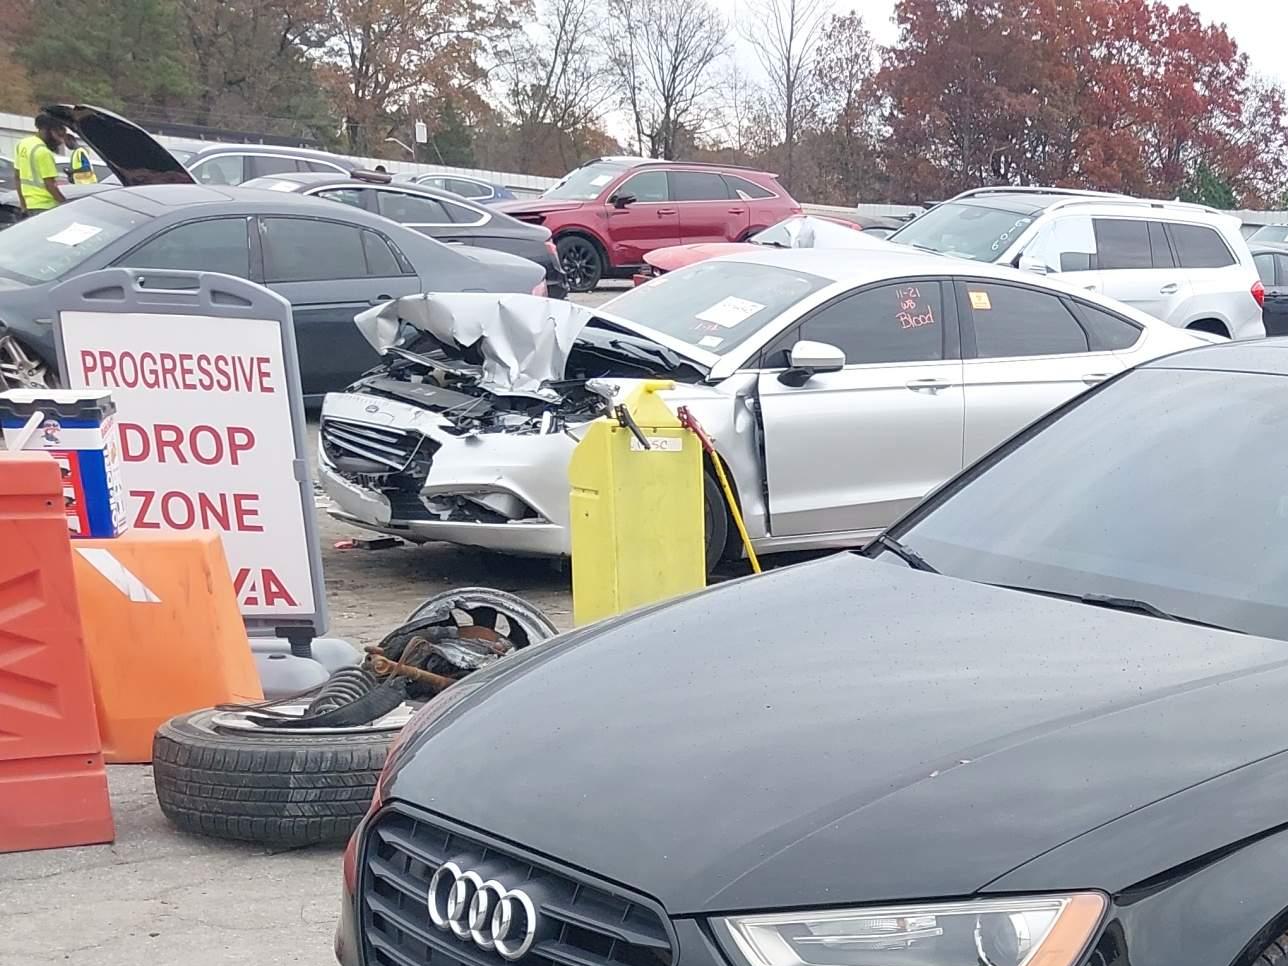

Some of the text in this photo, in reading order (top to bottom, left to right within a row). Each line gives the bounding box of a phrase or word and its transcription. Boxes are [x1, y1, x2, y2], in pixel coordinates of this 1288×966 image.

[896, 305, 934, 329] Blood
[80, 350, 275, 393] PROGRESSIVE
[117, 423, 256, 466] DROP
[129, 490, 264, 532] ZONE
